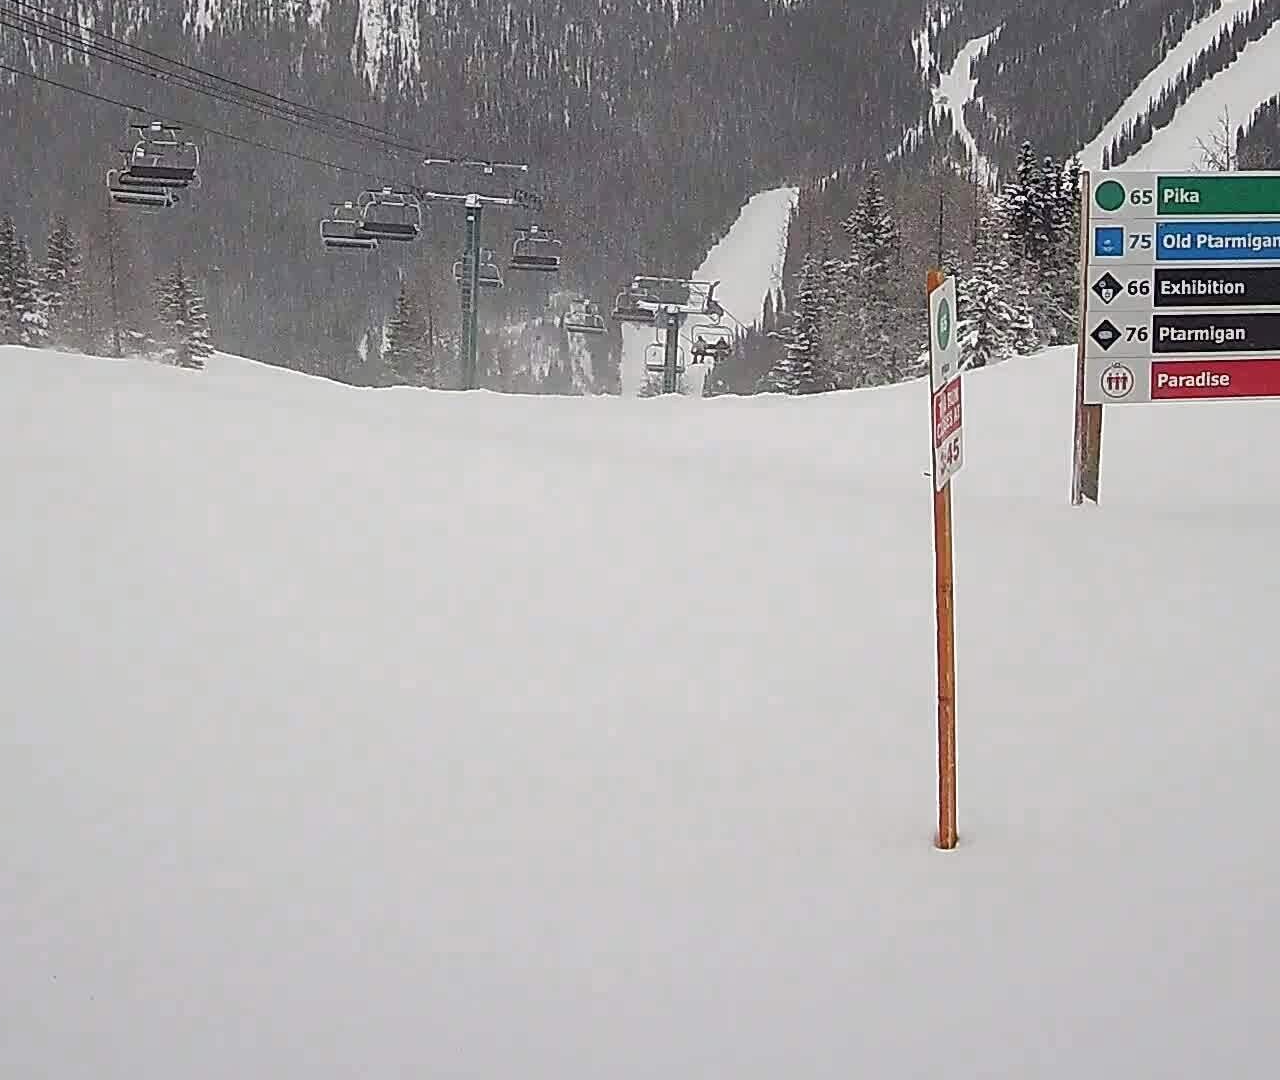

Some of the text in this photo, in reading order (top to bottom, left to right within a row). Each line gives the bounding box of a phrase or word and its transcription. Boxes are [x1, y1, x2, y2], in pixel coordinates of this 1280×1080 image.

[1130, 188, 1201, 205] 65 Pika
[1128, 234, 1152, 249] 75
[1162, 233, 1191, 249] Old
[1127, 280, 1245, 296] 66 Exhibition
[1125, 325, 1246, 346] 76 Ptarmigan
[1156, 372, 1231, 388] Paradise
